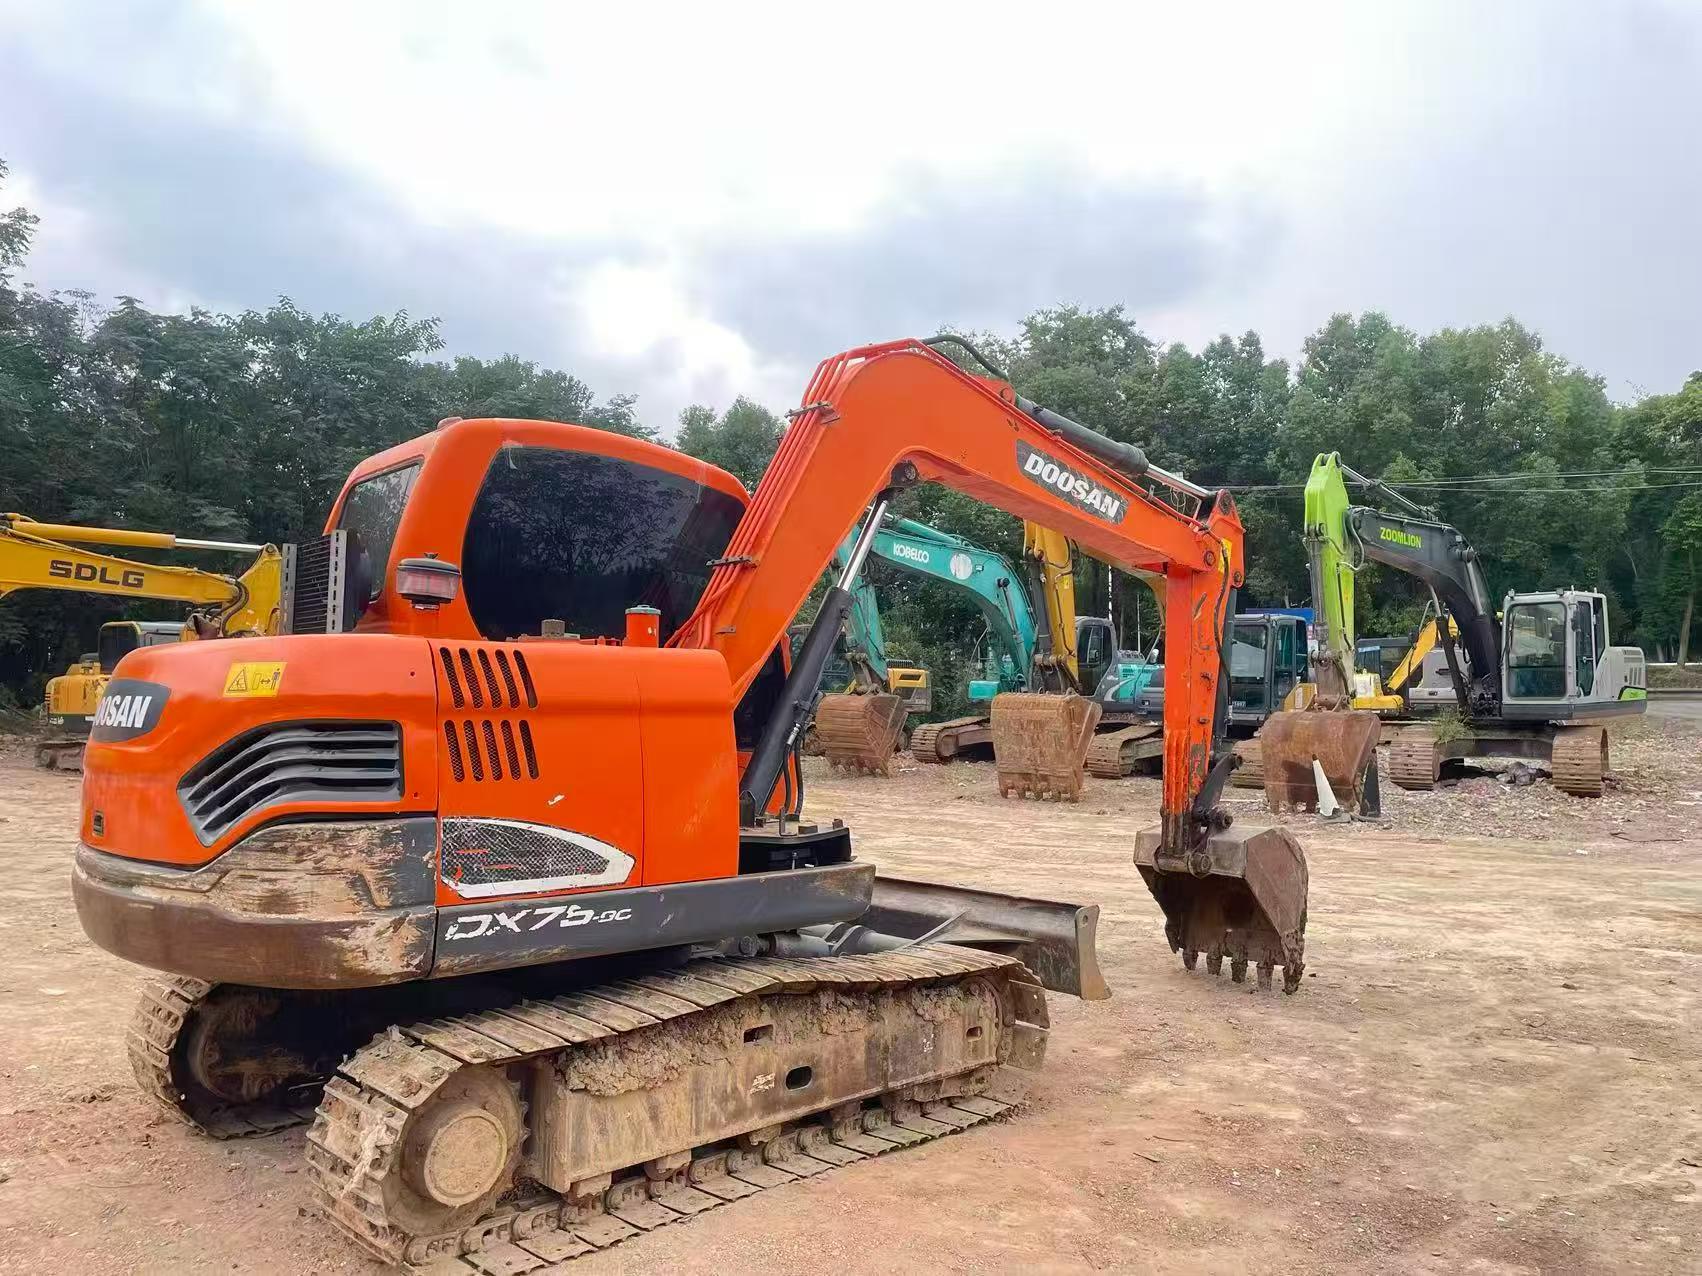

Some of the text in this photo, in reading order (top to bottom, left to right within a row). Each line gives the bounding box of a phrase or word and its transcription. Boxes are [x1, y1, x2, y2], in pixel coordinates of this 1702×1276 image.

[1024, 452, 1121, 518] DOOSAN
[1380, 526, 1422, 549] ZOOMLION
[893, 542, 930, 564] KOBELCO
[49, 559, 145, 589] SDLG
